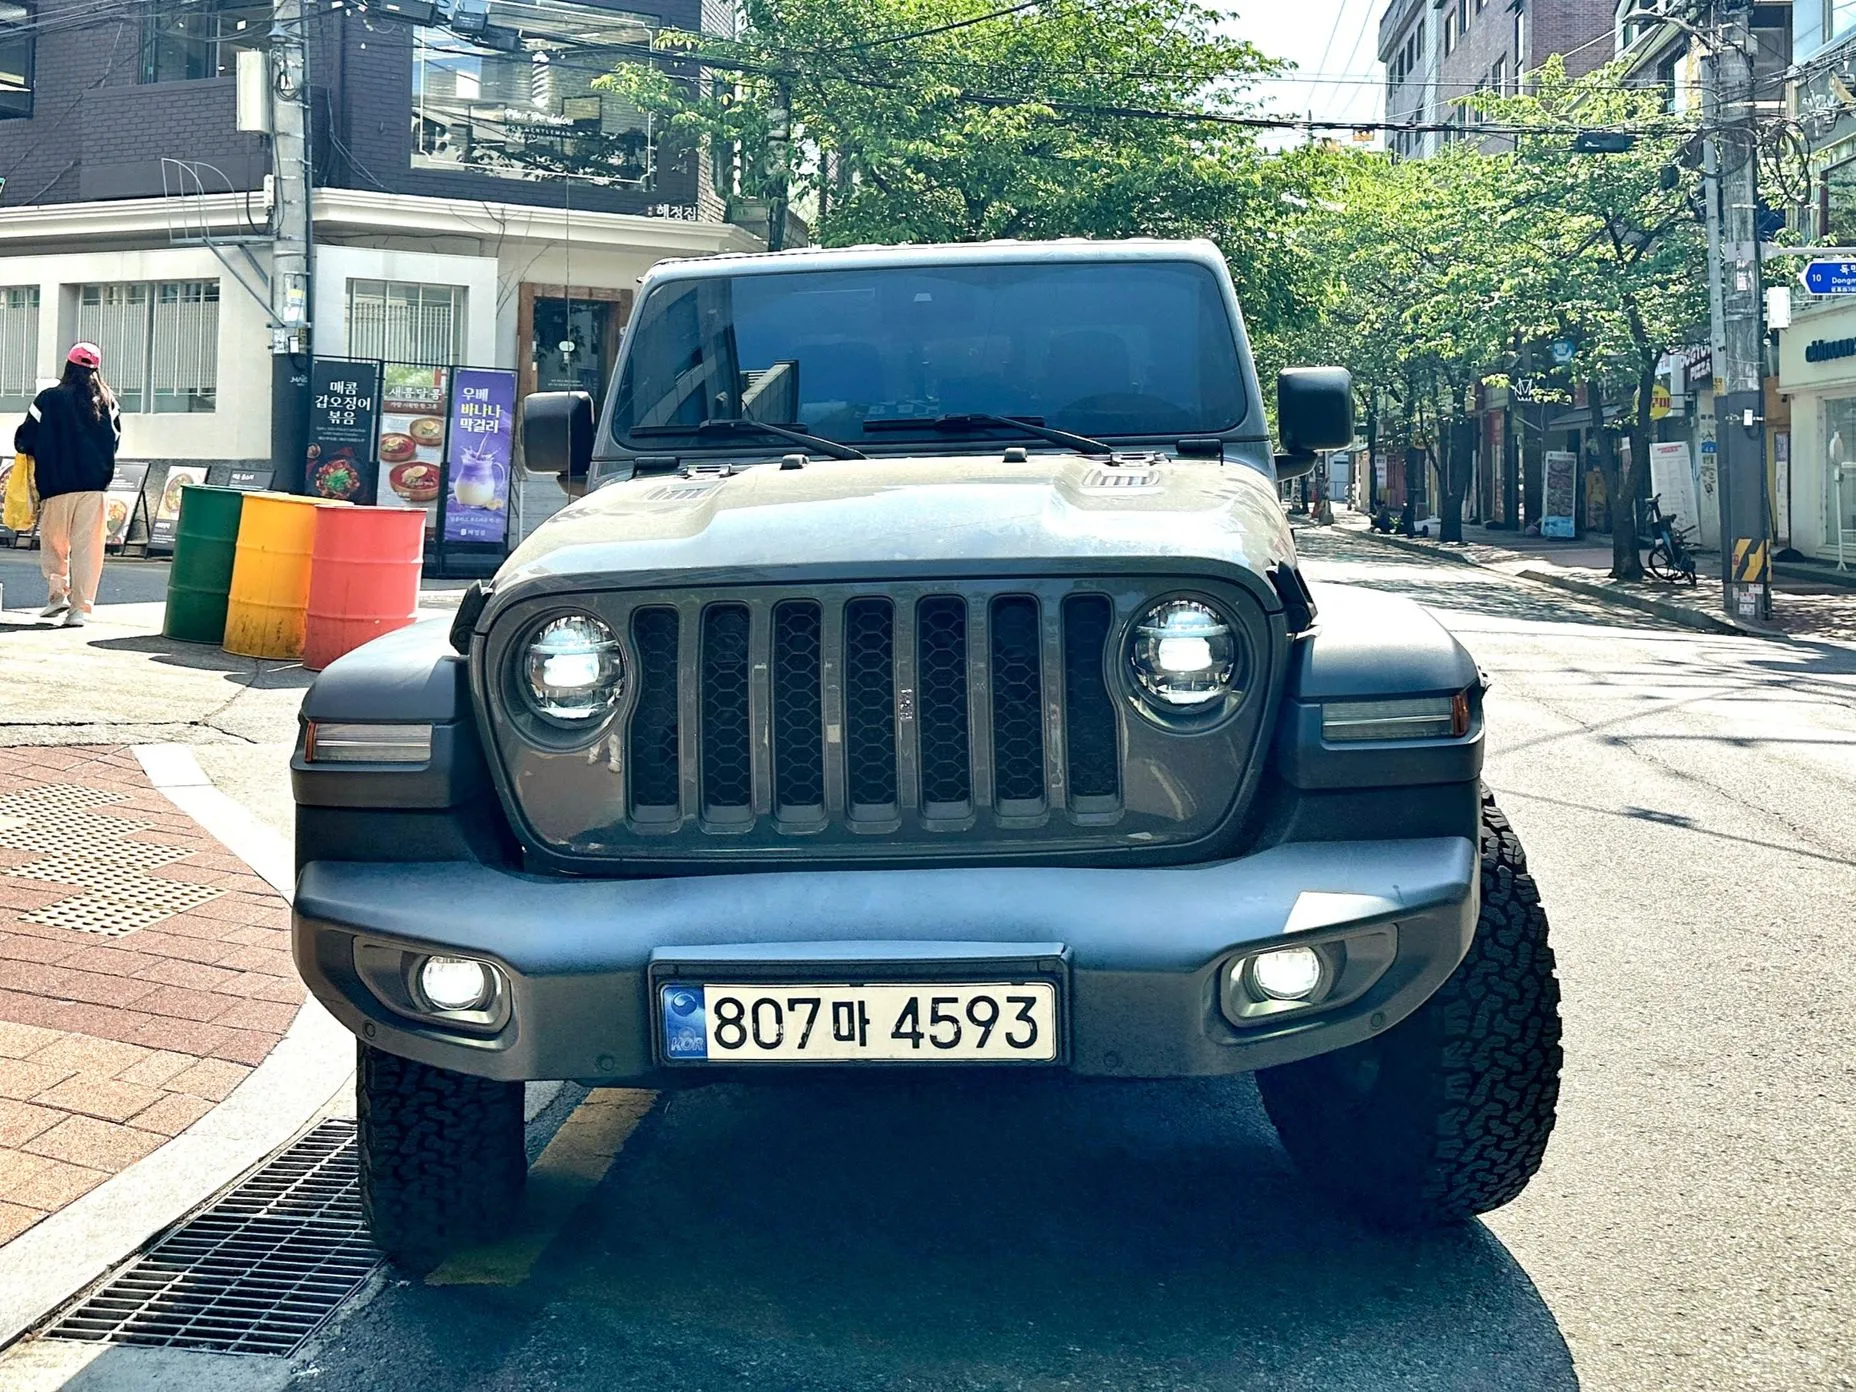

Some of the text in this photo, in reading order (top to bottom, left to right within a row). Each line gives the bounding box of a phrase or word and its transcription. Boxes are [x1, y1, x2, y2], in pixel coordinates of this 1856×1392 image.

[1812, 274, 1822, 282] 10
[330, 381, 358, 395] 매콤
[461, 387, 489, 401] 우베
[315, 395, 371, 411] 갑오징어
[461, 403, 503, 418] 바나나
[328, 411, 357, 425] 볶음
[460, 418, 499, 433] 막걸리
[714, 996, 1038, 1049] 807마 4593
